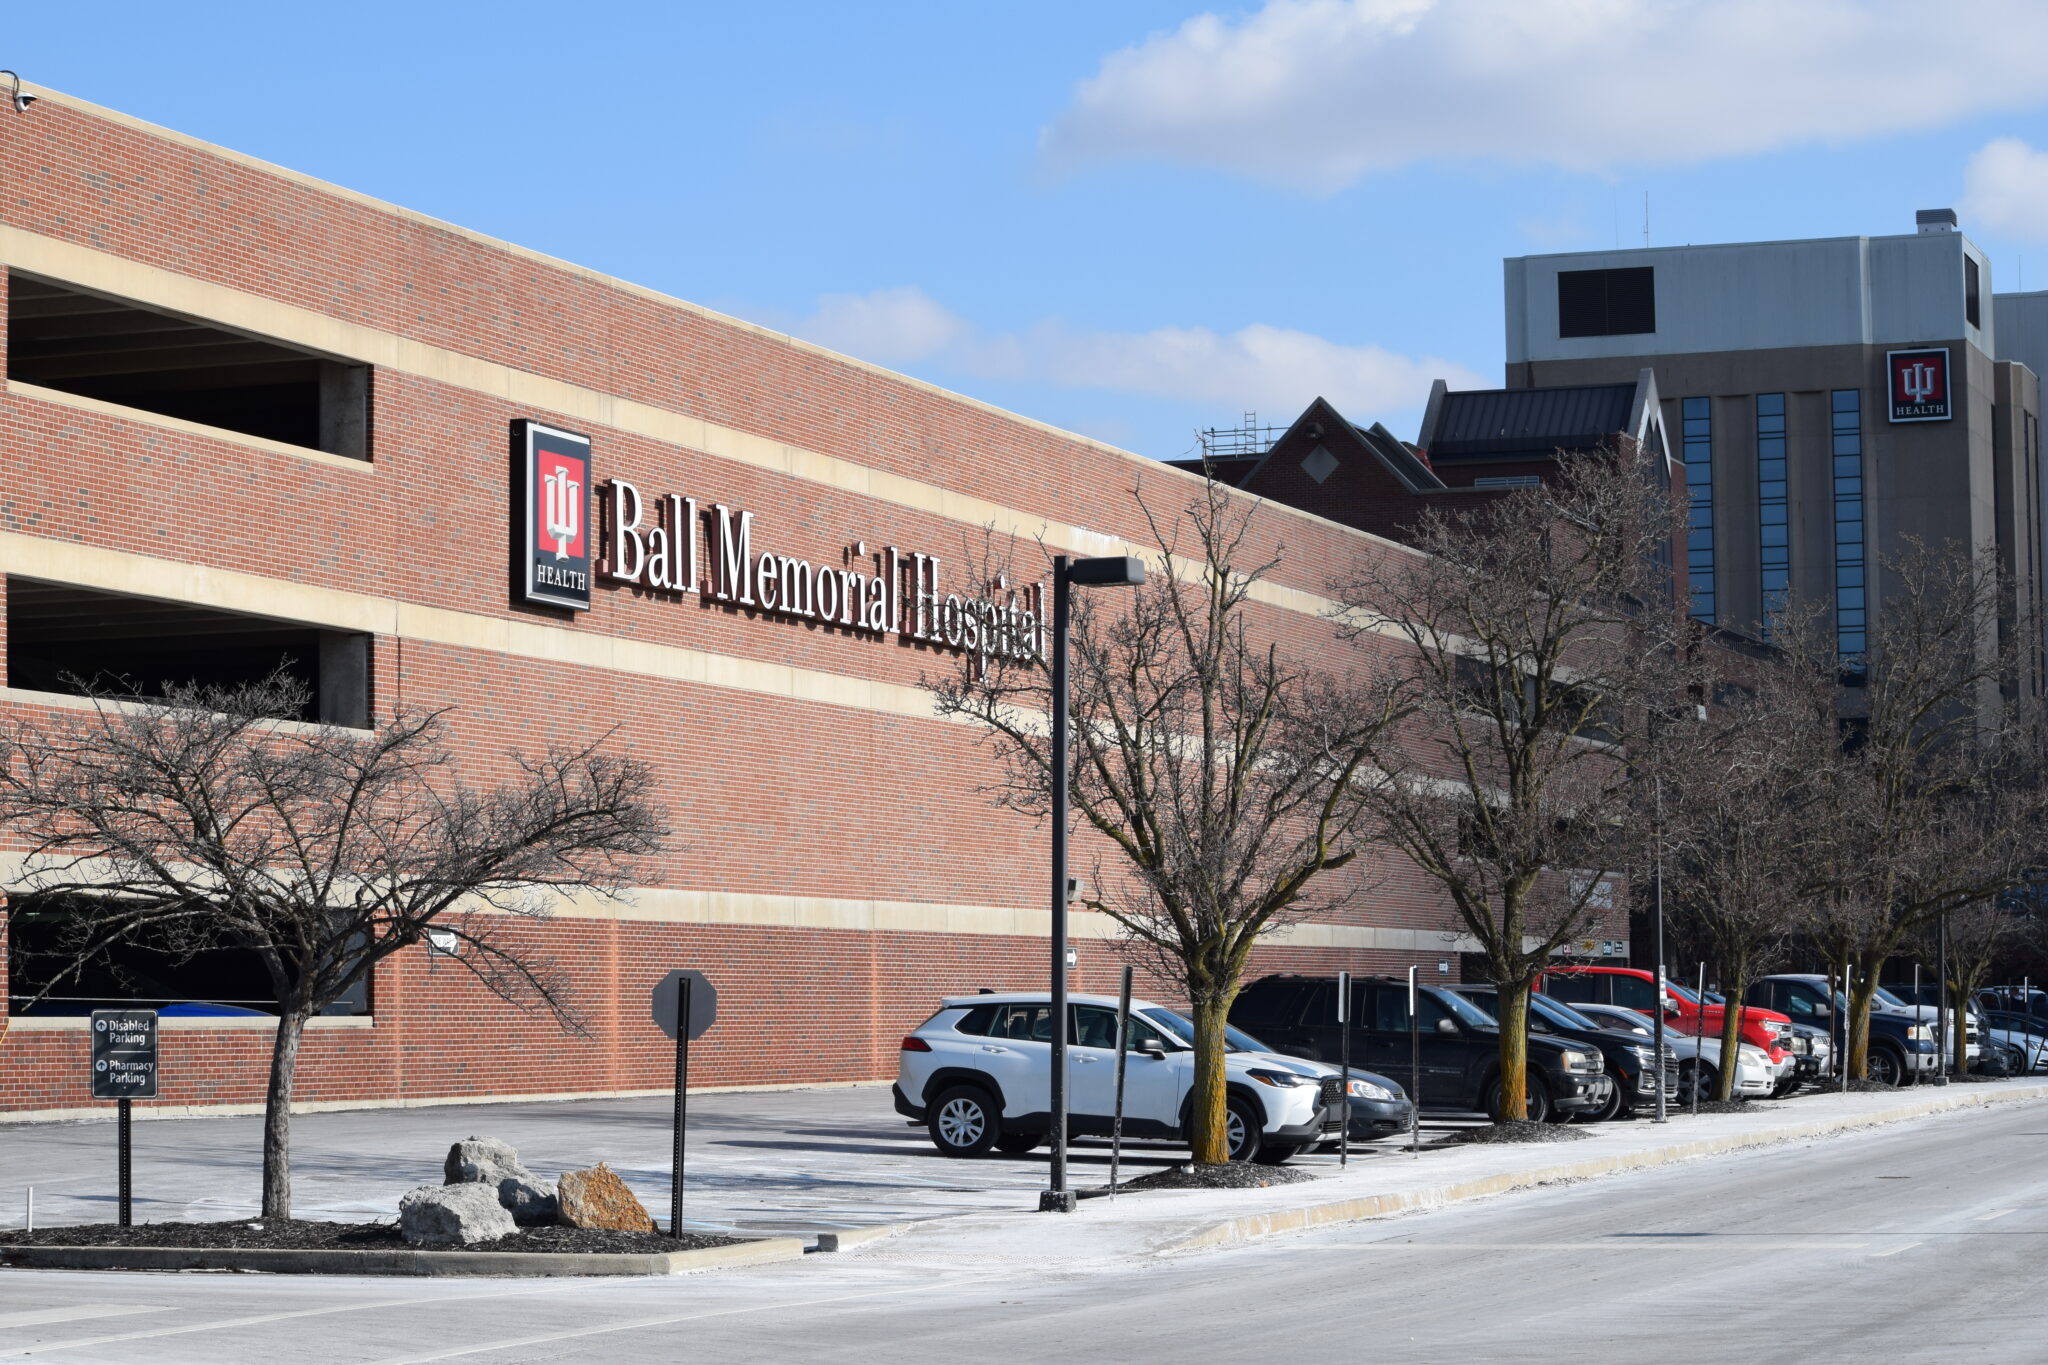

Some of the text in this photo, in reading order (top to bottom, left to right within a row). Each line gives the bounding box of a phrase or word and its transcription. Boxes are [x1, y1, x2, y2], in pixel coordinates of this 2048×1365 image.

[1896, 404, 1945, 416] HEALTH
[537, 564, 586, 591] HEALTH
[611, 478, 1047, 683] Ball Memorial Hospital
[109, 1019, 149, 1031] Disabled
[109, 1032, 146, 1046] Parking
[109, 1060, 154, 1073] Pharmacy
[109, 1072, 146, 1086] Parking
